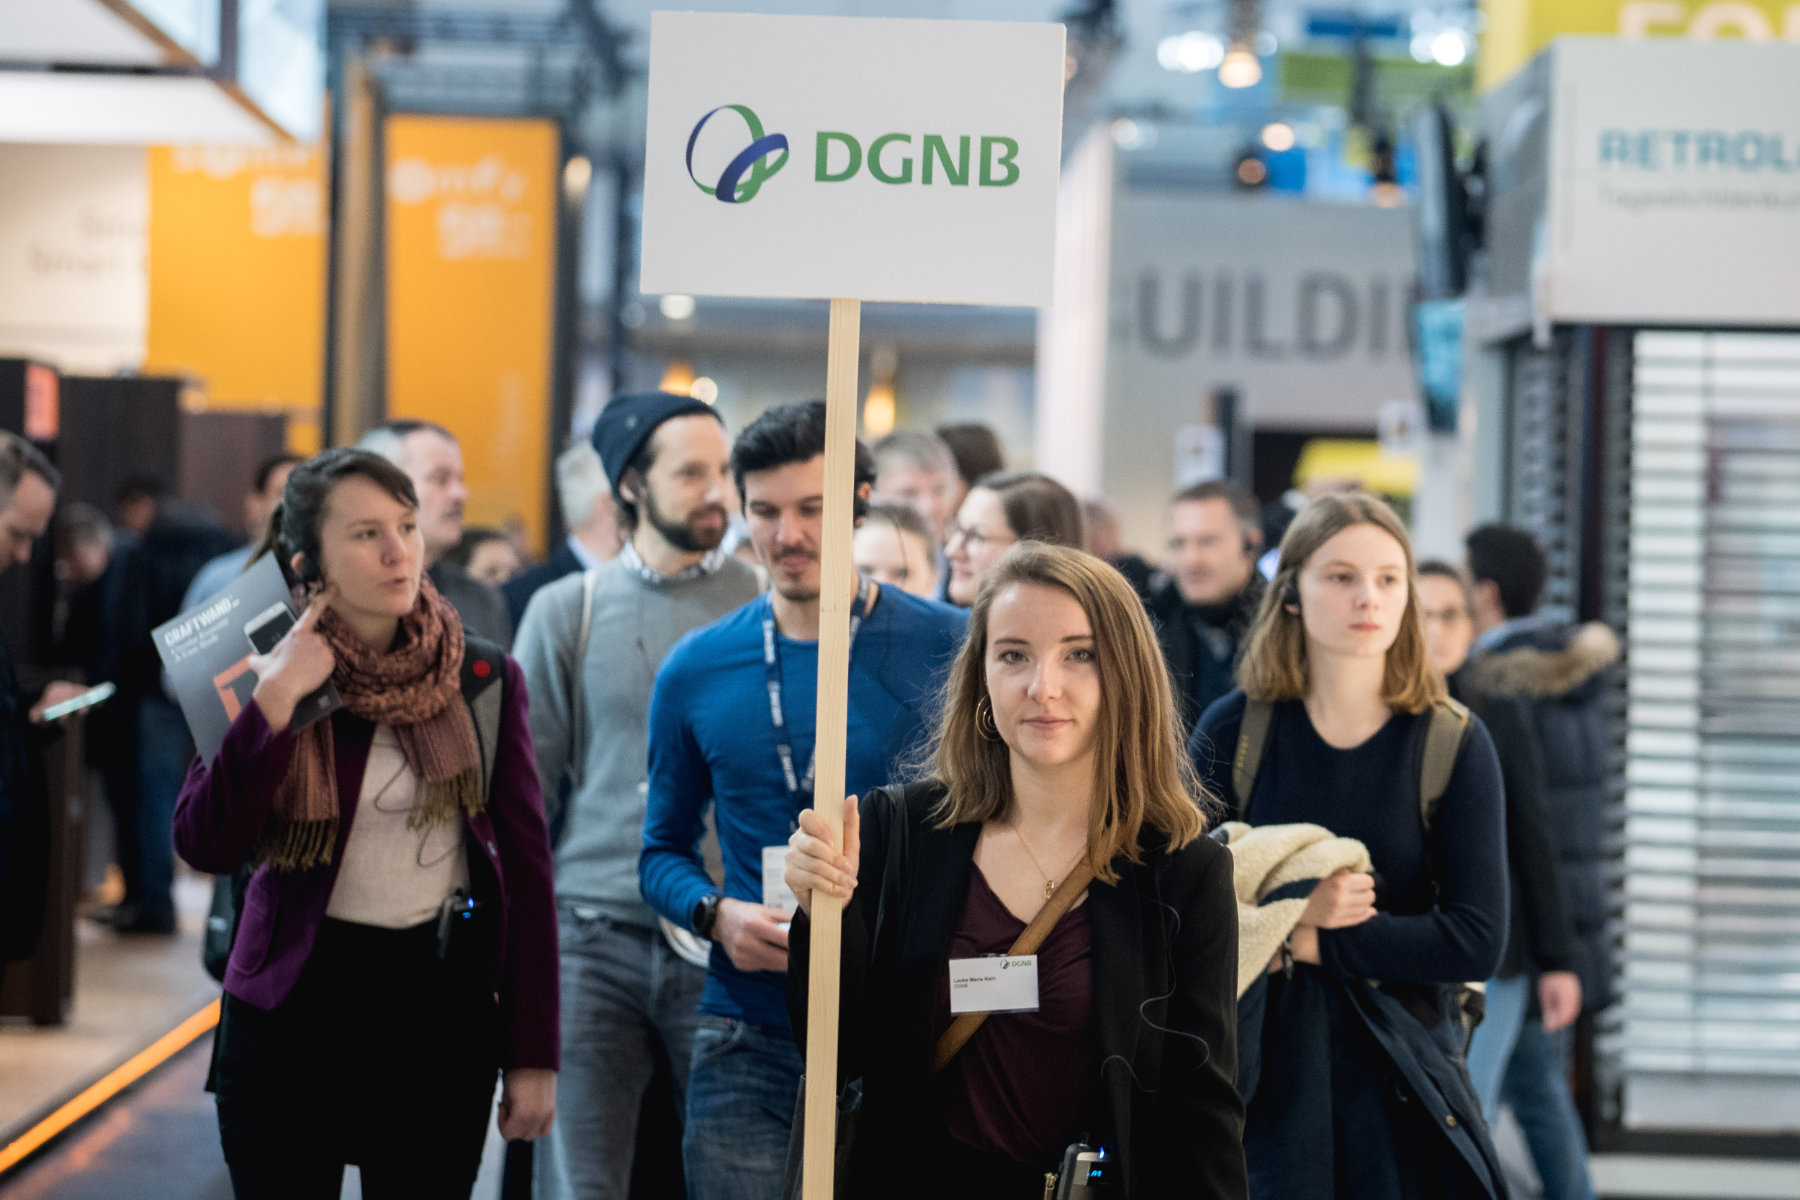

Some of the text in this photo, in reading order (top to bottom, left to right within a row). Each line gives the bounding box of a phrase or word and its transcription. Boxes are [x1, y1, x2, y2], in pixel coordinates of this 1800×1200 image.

[814, 131, 1021, 188] DGNB
[1599, 129, 1800, 172] RETROL
[1011, 960, 1032, 968] DGNB
